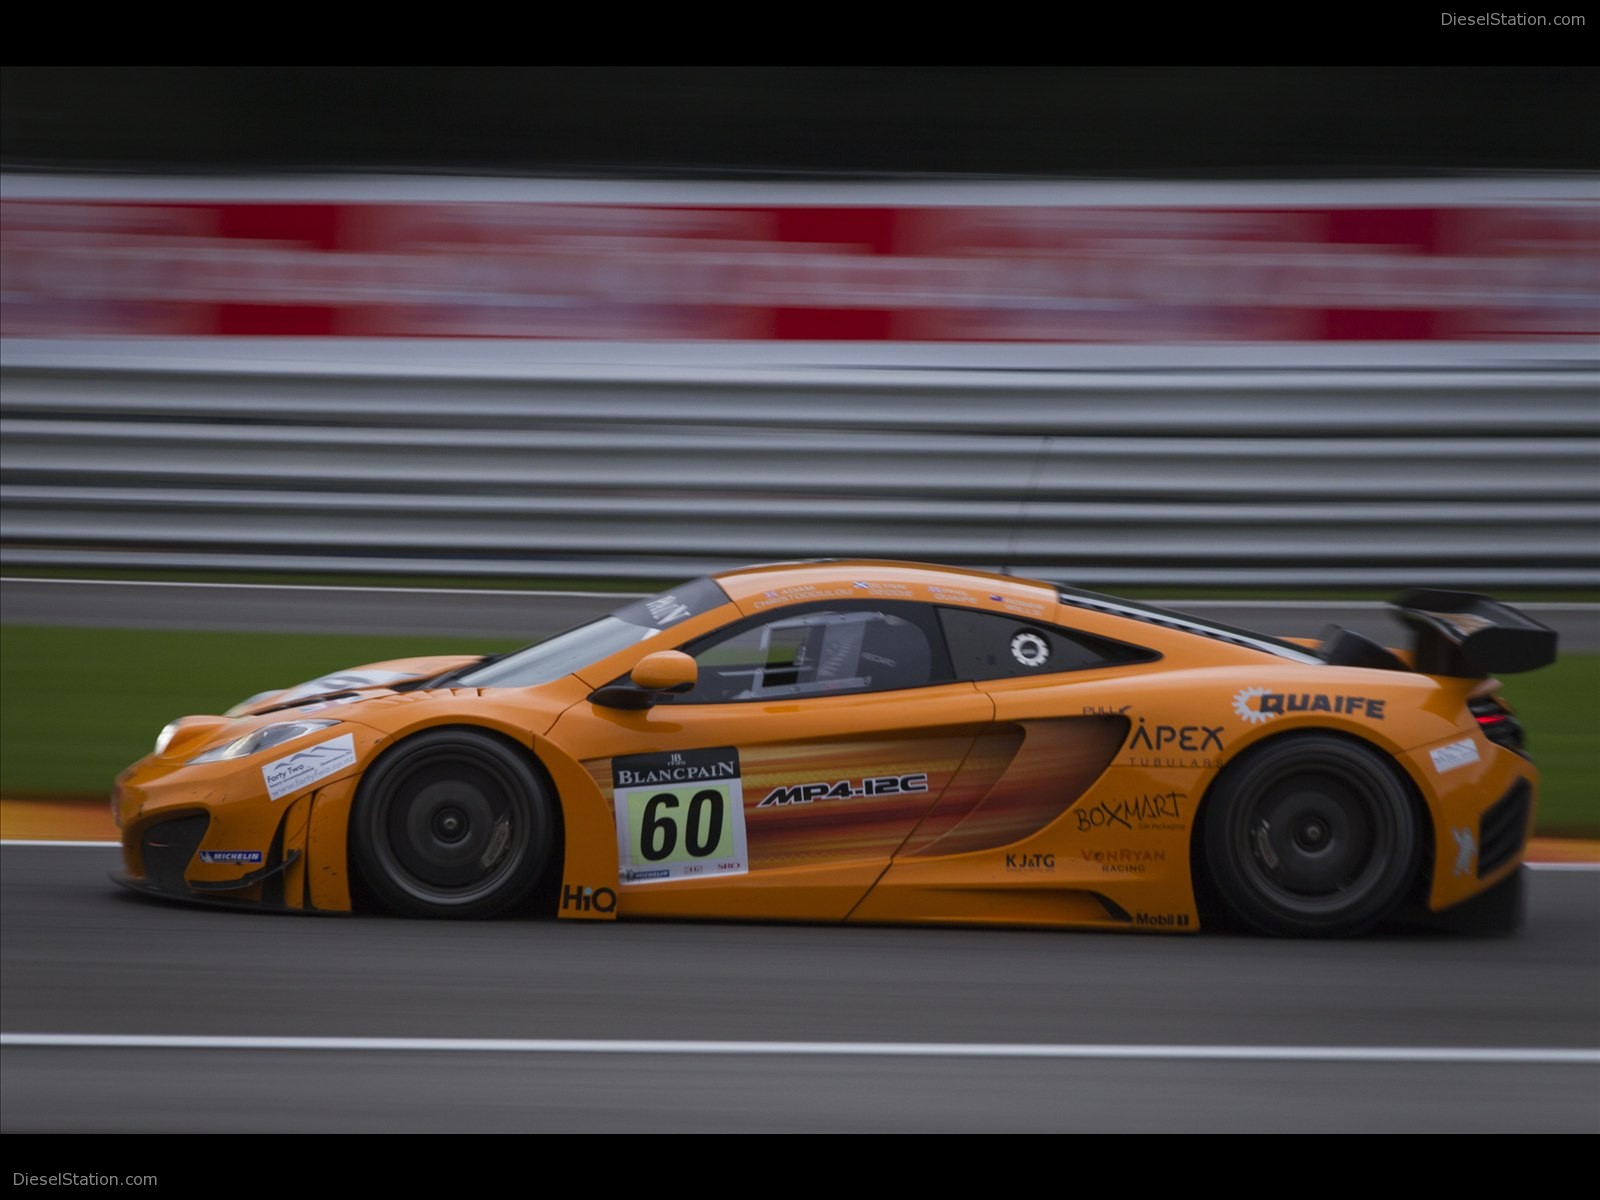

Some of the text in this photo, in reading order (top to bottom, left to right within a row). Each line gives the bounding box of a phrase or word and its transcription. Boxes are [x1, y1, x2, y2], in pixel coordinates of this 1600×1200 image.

[1259, 693, 1386, 720] QUAIFE
[1129, 717, 1224, 751] APEX
[618, 761, 735, 785] BLANCPAIN
[757, 773, 928, 808] MP4-12C
[640, 789, 724, 862] 60
[1073, 791, 1187, 832] BOXMART
[213, 852, 260, 861] MICHELIN
[1102, 863, 1145, 873] RACING
[563, 884, 617, 913] HiQ
